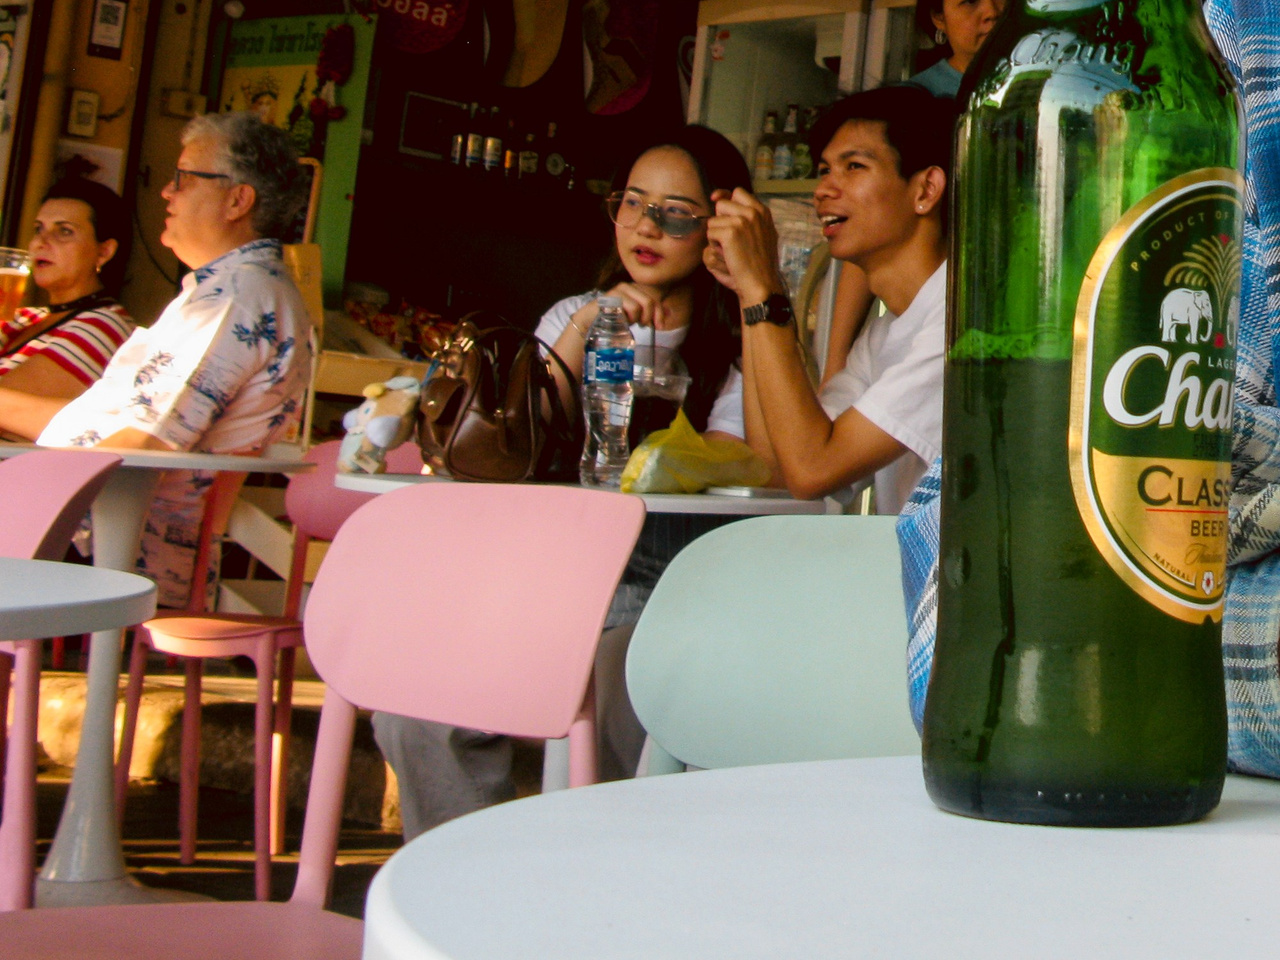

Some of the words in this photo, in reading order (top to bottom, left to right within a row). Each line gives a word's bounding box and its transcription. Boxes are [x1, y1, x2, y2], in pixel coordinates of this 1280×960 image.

[1130, 212, 1206, 272] PRODUCT
[1215, 211, 1230, 221] OF
[1153, 552, 1191, 581] NATURAL
